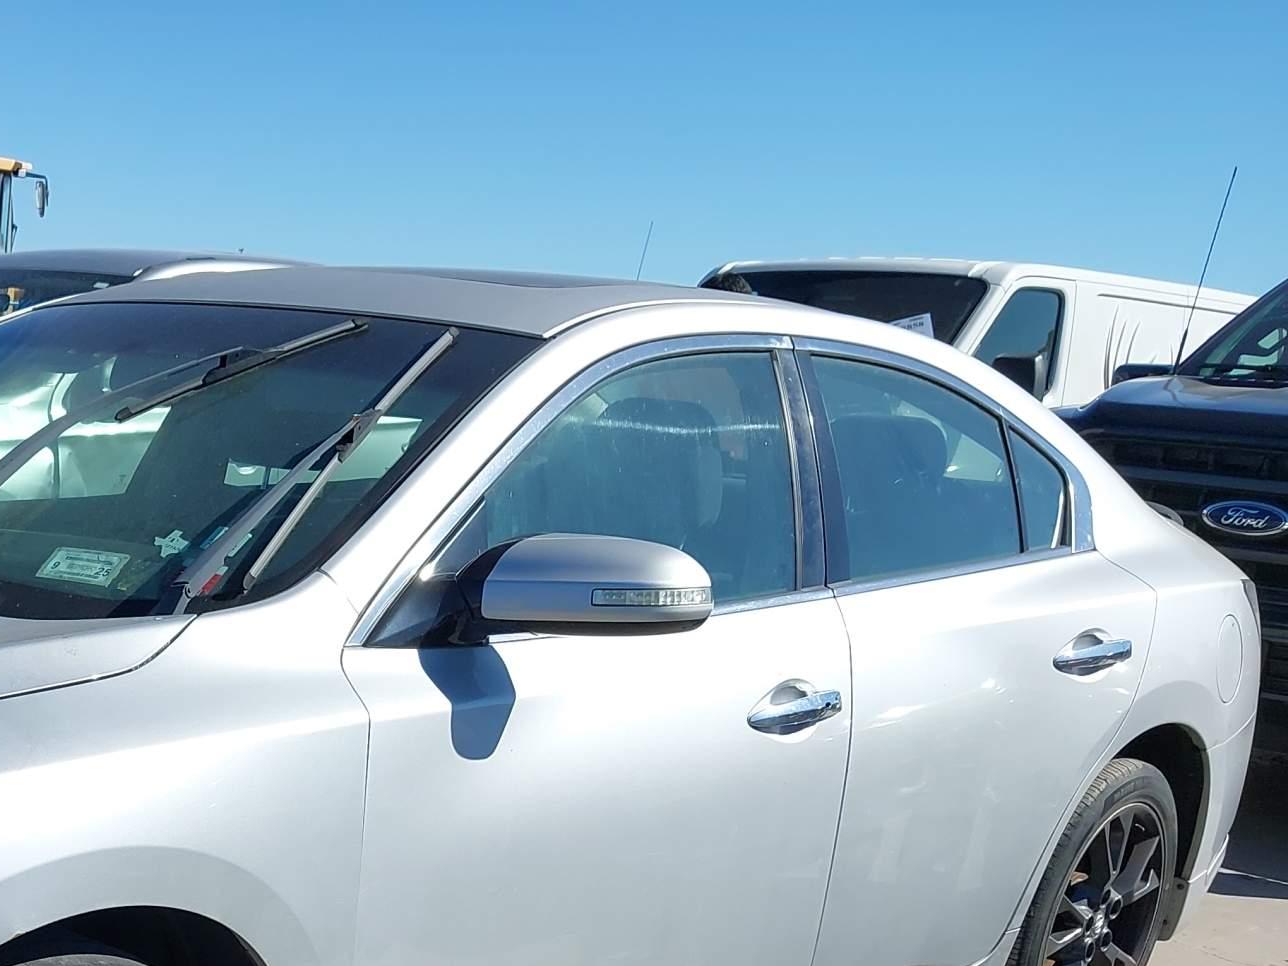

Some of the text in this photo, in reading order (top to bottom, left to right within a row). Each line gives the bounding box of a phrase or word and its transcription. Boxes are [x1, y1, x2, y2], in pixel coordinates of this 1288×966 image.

[1221, 507, 1271, 528] Ford
[50, 561, 62, 570] 9
[94, 567, 112, 577] 25
